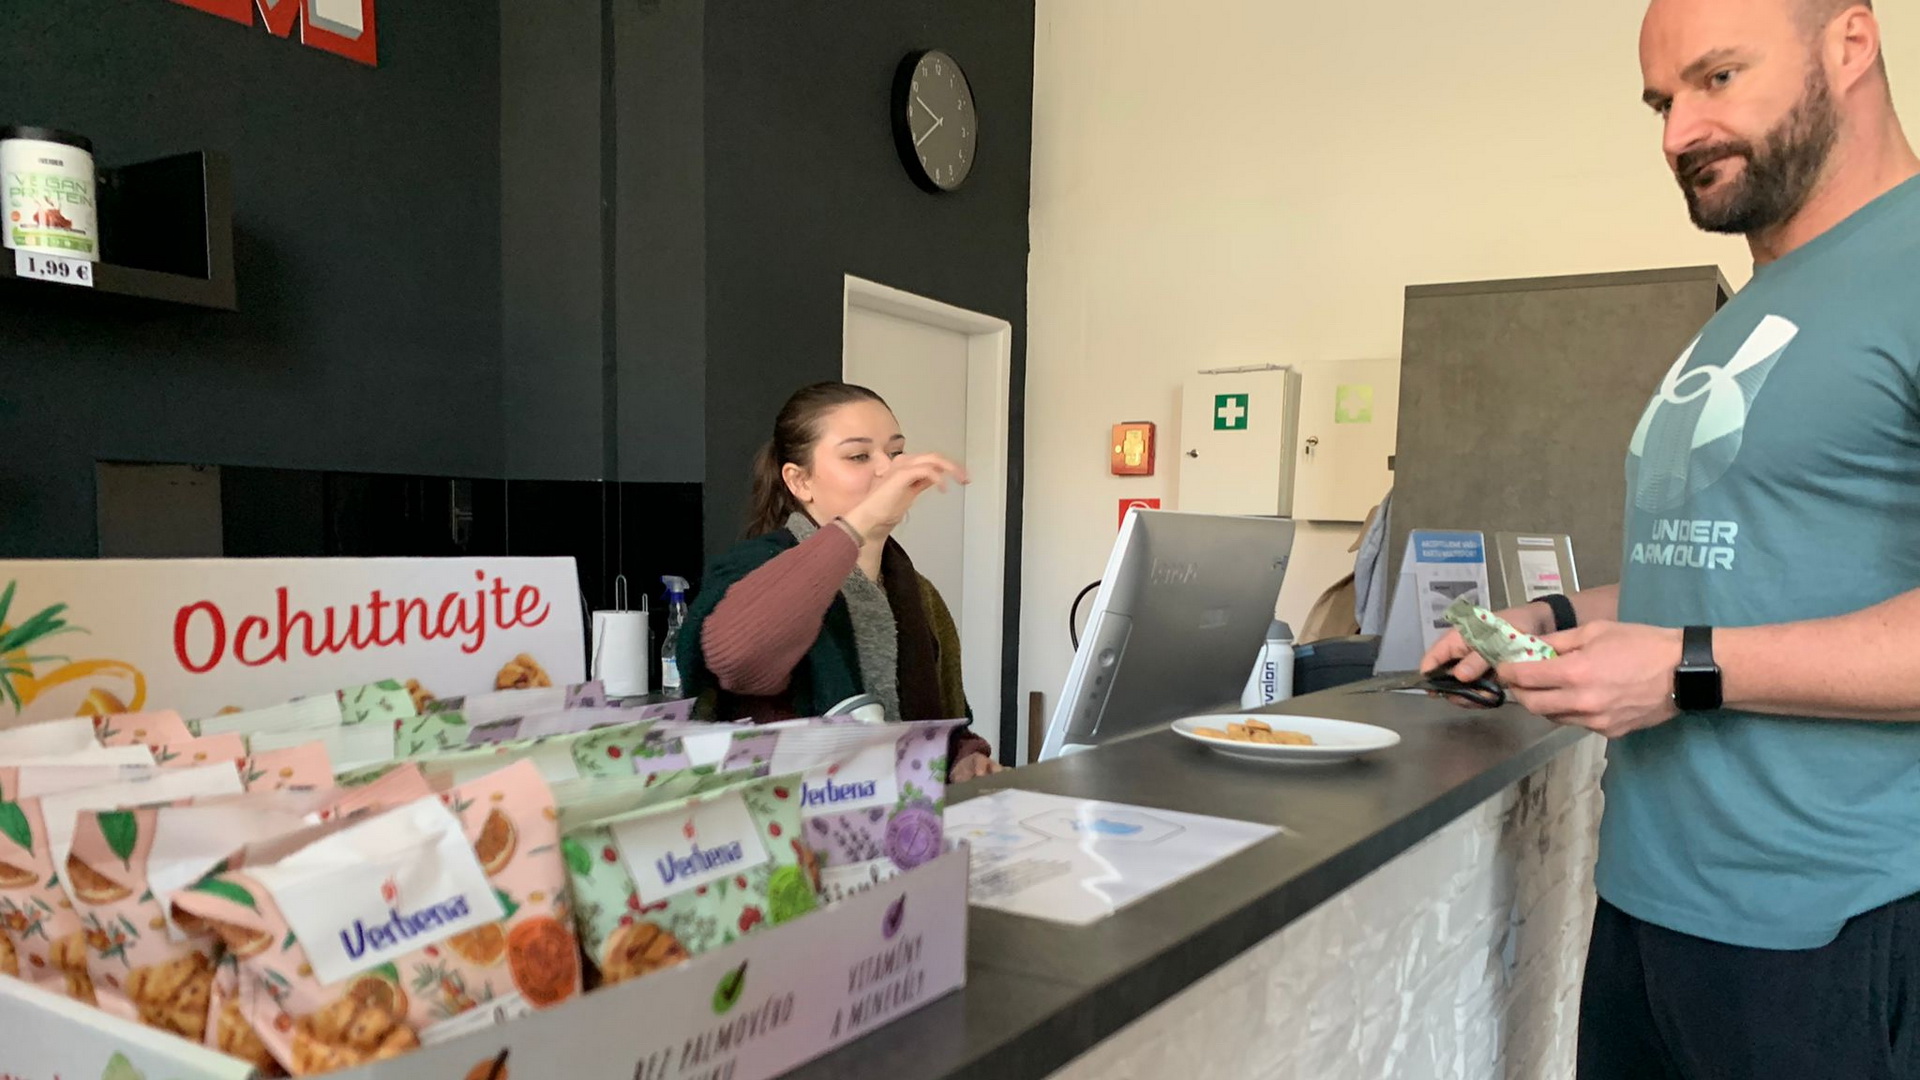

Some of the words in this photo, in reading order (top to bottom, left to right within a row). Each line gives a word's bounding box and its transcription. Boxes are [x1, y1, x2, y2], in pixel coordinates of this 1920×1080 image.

[28, 256, 70, 278] 1,99
[76, 265, 89, 280] €
[1651, 519, 1739, 545] UNDER
[1629, 542, 1736, 571] ARMOUR
[173, 569, 551, 674] Ochutnajte
[656, 841, 743, 886] Verbena
[340, 894, 470, 961] Verbena
